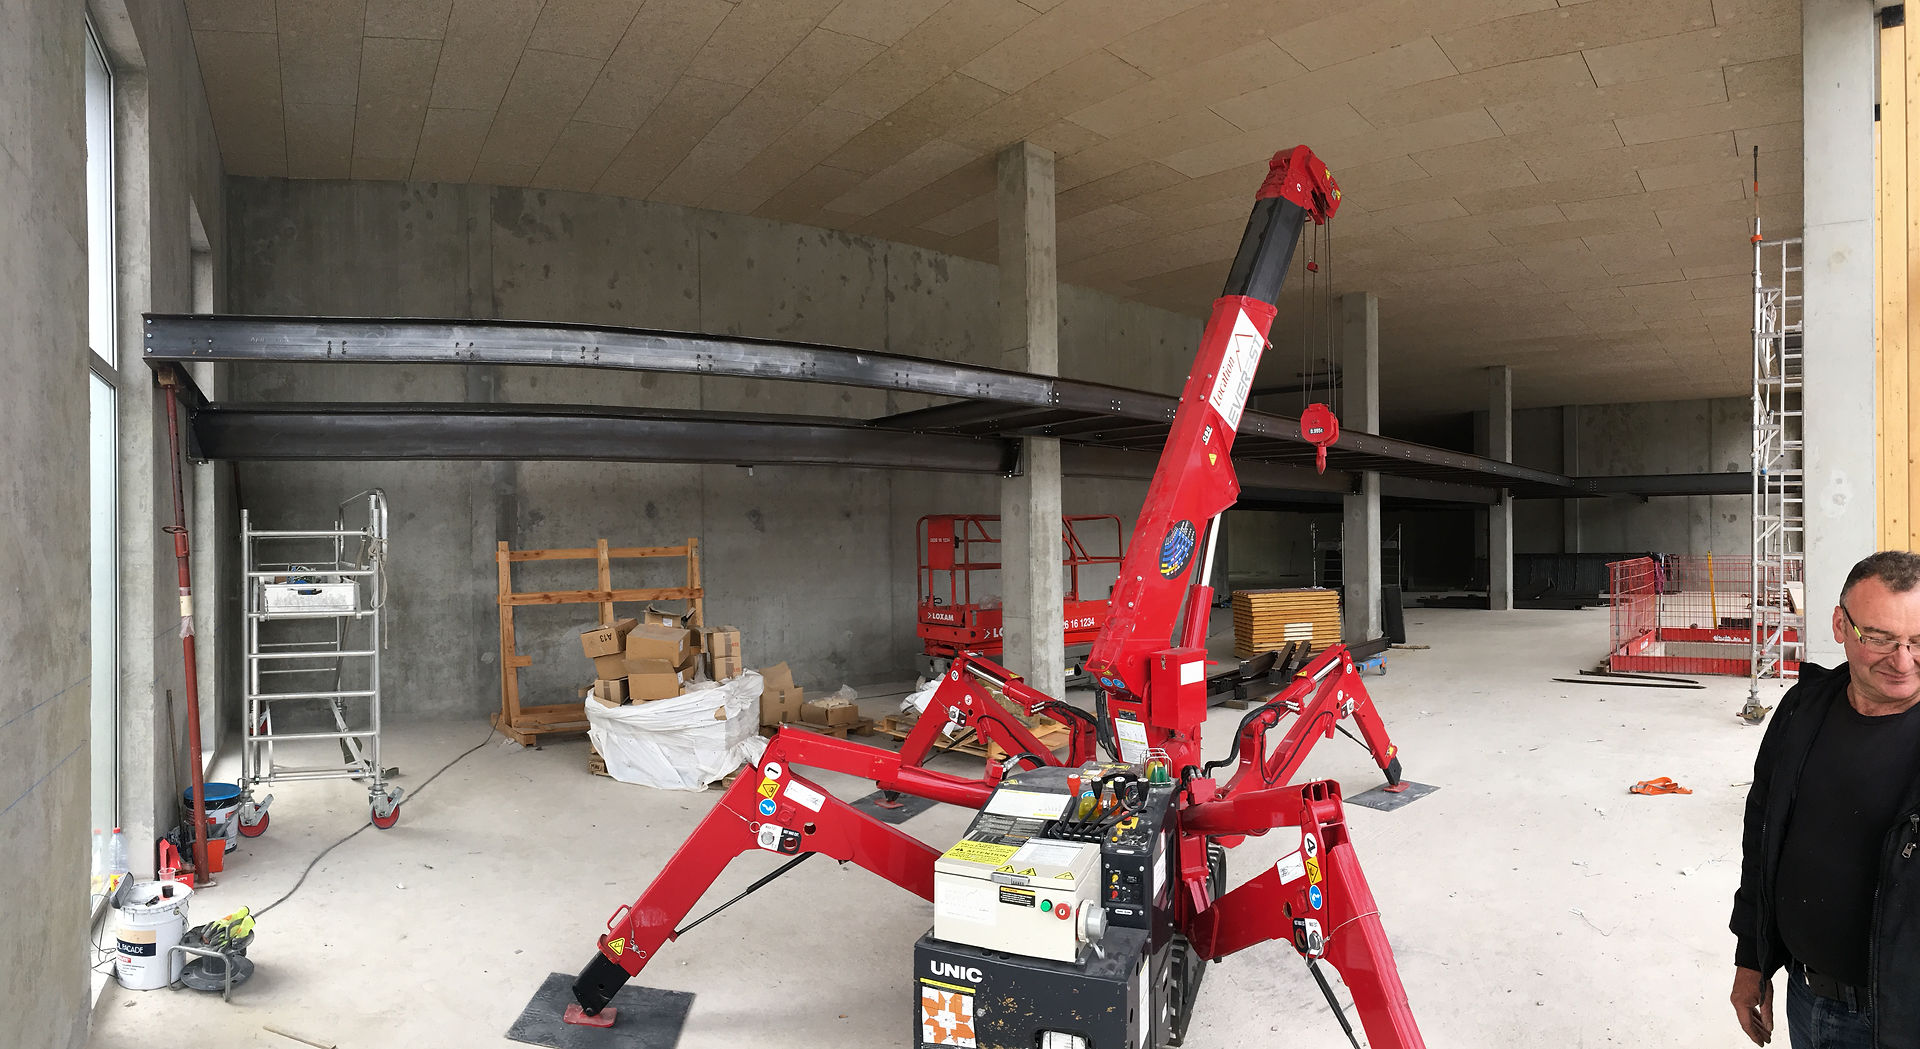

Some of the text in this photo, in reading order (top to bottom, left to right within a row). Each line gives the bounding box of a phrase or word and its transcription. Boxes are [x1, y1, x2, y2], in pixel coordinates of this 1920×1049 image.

[1213, 356, 1235, 407] Location
[1228, 333, 1261, 426] EVEREST
[932, 612, 954, 621] LOXAM
[1071, 619, 1079, 629] 16
[1080, 617, 1095, 628] 1234
[599, 632, 612, 643] A13
[766, 766, 779, 774] 1
[1306, 837, 1316, 853] 4
[930, 959, 983, 984] UNIC
